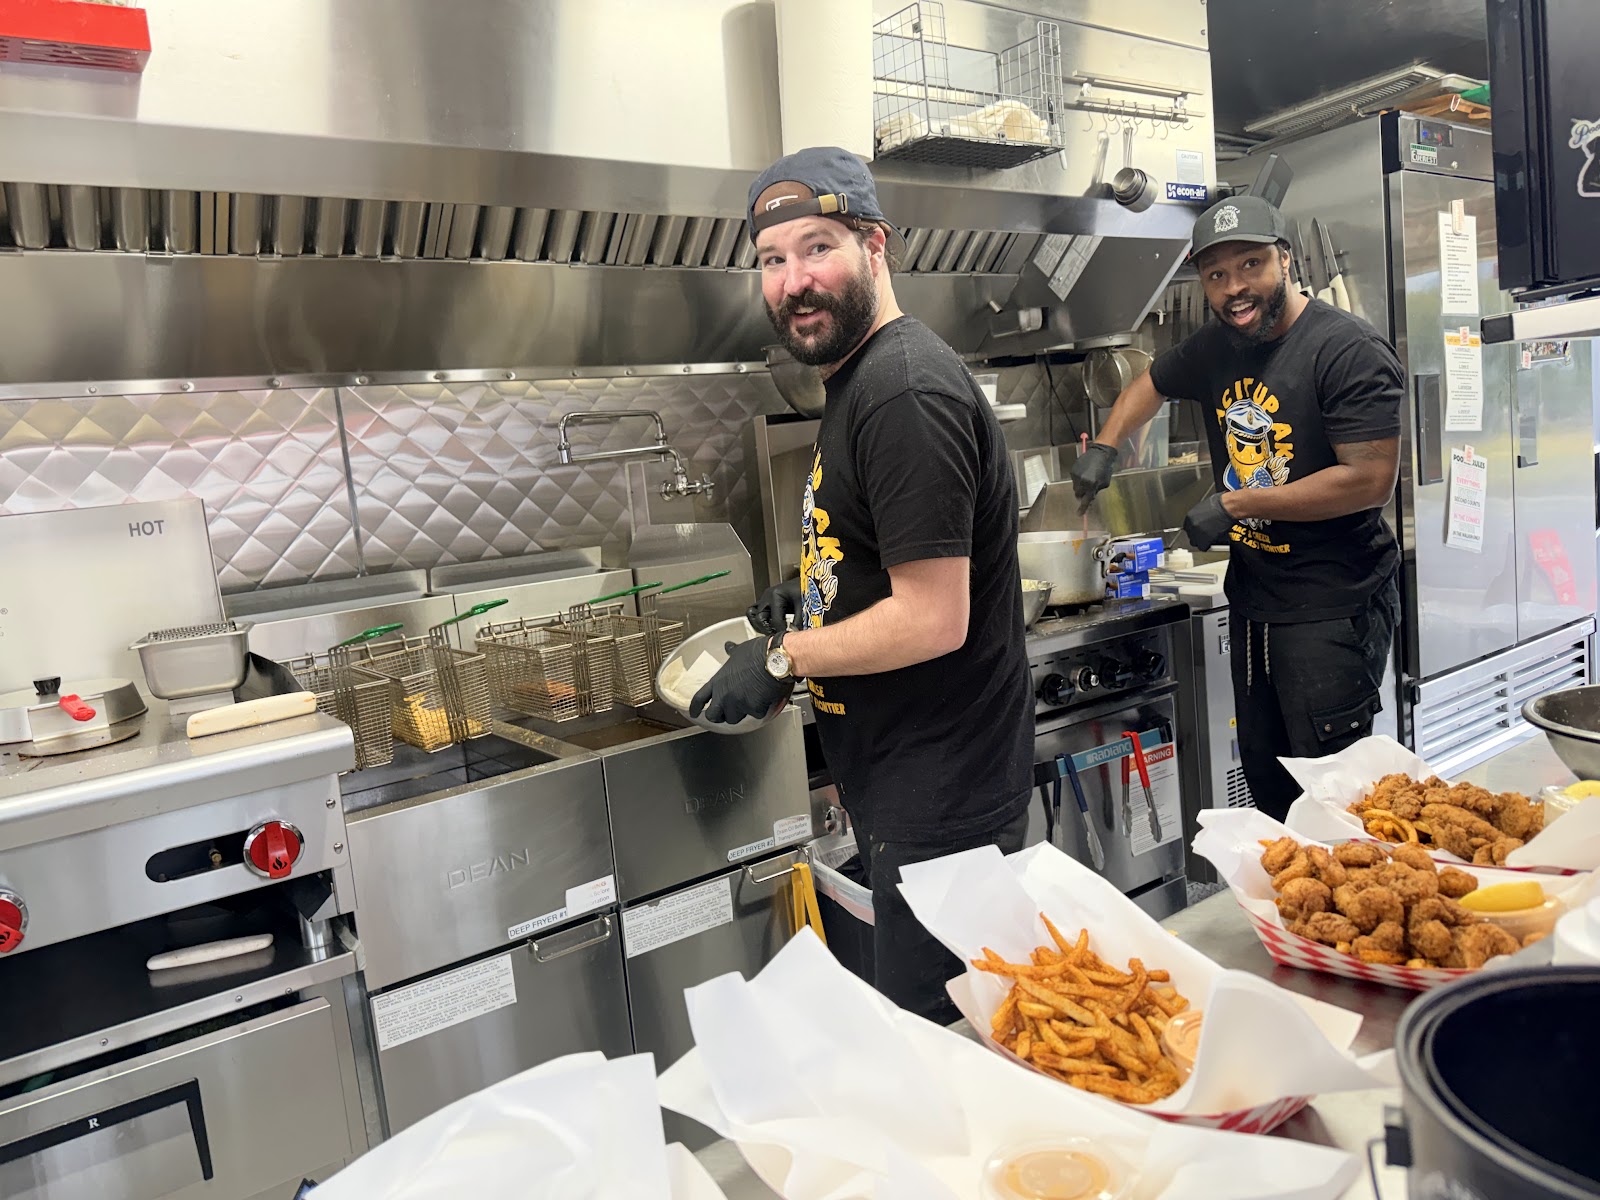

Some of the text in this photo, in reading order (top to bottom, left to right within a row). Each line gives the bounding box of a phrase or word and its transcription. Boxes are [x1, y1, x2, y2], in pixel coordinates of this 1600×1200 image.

[1177, 186, 1206, 197] econ-air
[1253, 381, 1280, 414] UP
[129, 519, 164, 537] HOT
[1144, 747, 1171, 763] ARNING
[777, 827, 788, 835] Drain
[778, 829, 808, 841] Transportation
[728, 848, 745, 859] DEEP
[745, 842, 766, 853] FRYER
[447, 848, 529, 889] DEAN
[509, 910, 568, 938] DEEP FRYER #1
